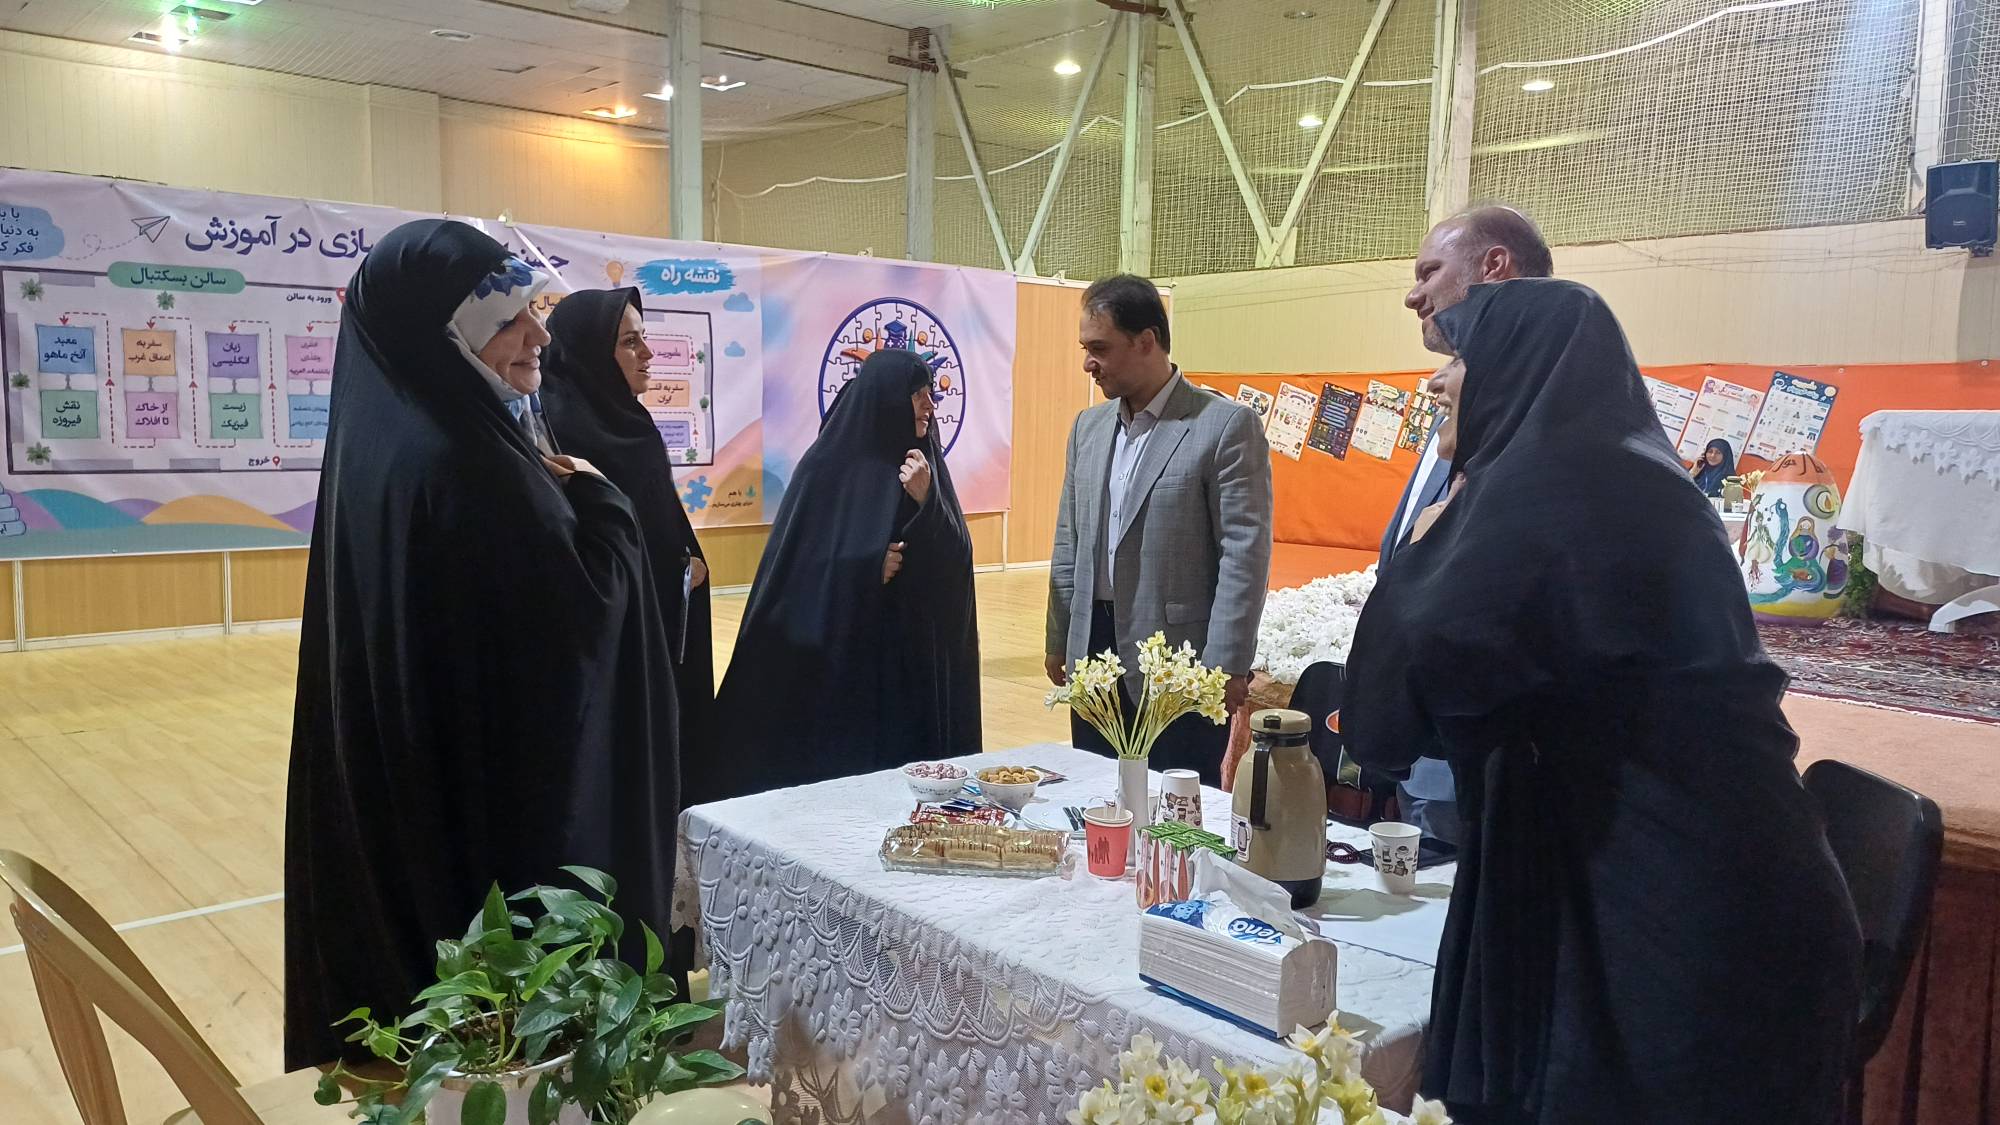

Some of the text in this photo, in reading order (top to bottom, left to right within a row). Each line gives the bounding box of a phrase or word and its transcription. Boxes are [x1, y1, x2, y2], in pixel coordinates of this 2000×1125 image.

[10, 207, 20, 222] با
[26, 228, 39, 240] به
[185, 215, 282, 255] آموزش
[282, 227, 312, 254] در
[13, 241, 34, 256] فکر
[130, 267, 227, 289] سالن بسکتبال
[661, 264, 721, 286] نقشه راه
[286, 291, 333, 304] ورود به سالن
[54, 336, 78, 347] معبد
[222, 341, 241, 353] زبان
[212, 355, 250, 368] انگلیسی
[55, 400, 81, 413] نقش
[135, 402, 168, 414] از خاک
[52, 414, 82, 428] فیروزه
[135, 416, 170, 426] تا افلاک
[248, 455, 270, 467] خروج
